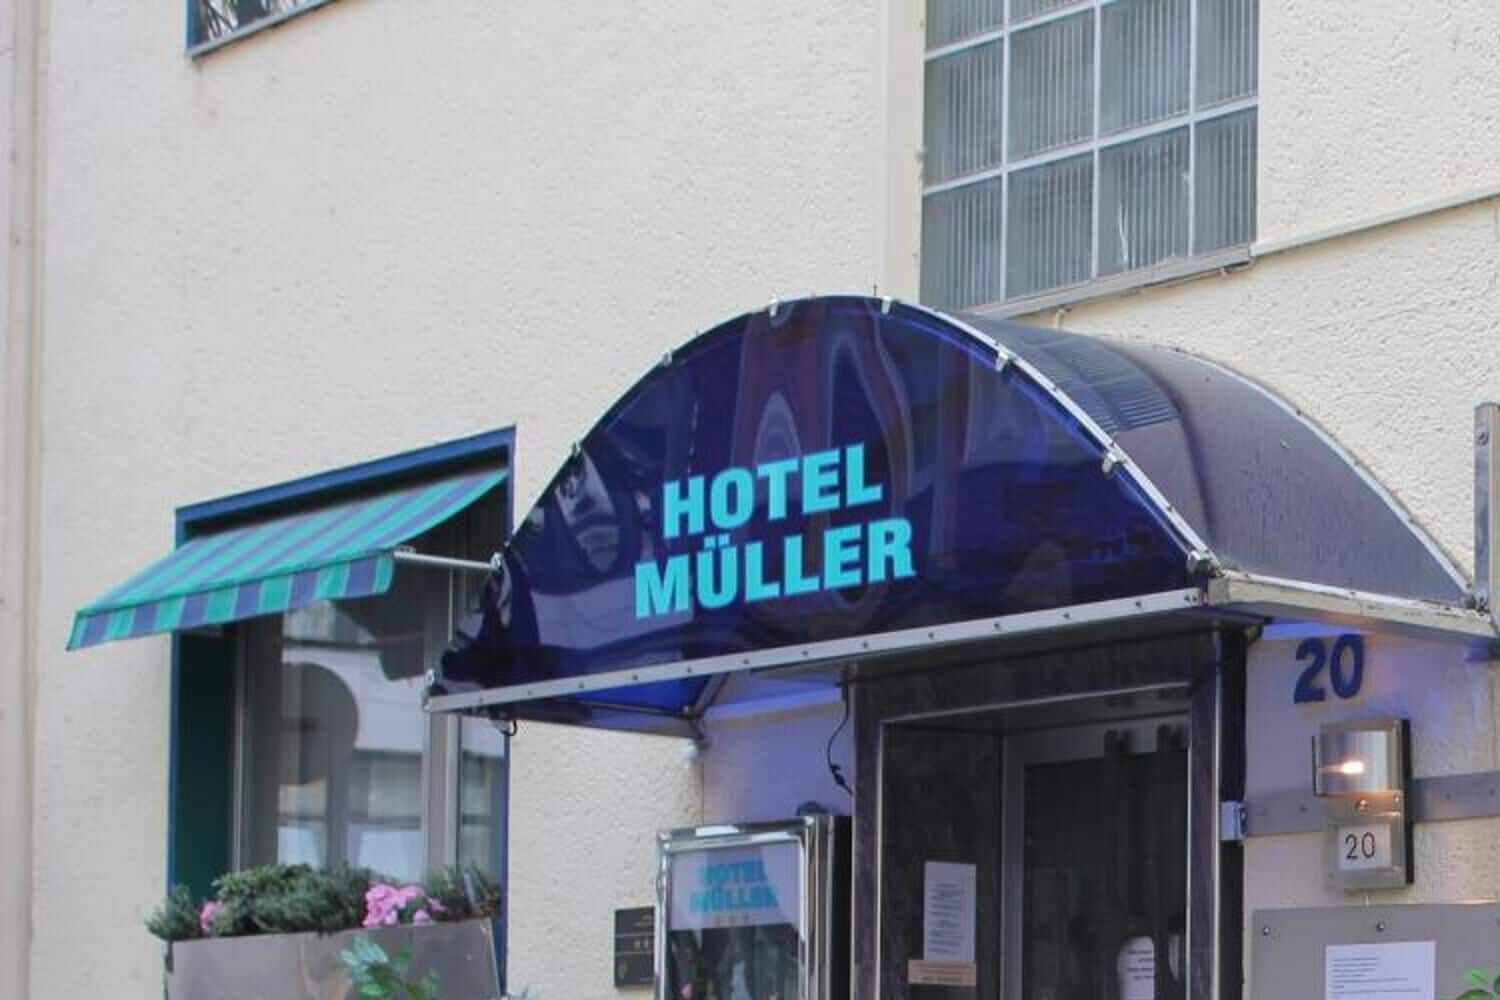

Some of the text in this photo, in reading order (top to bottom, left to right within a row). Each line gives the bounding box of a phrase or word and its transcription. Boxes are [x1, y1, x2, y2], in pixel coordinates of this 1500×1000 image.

[663, 442, 883, 540] HOTEL
[634, 517, 916, 620] MÜLLER
[1293, 633, 1365, 704] 20
[1344, 831, 1376, 860] 20
